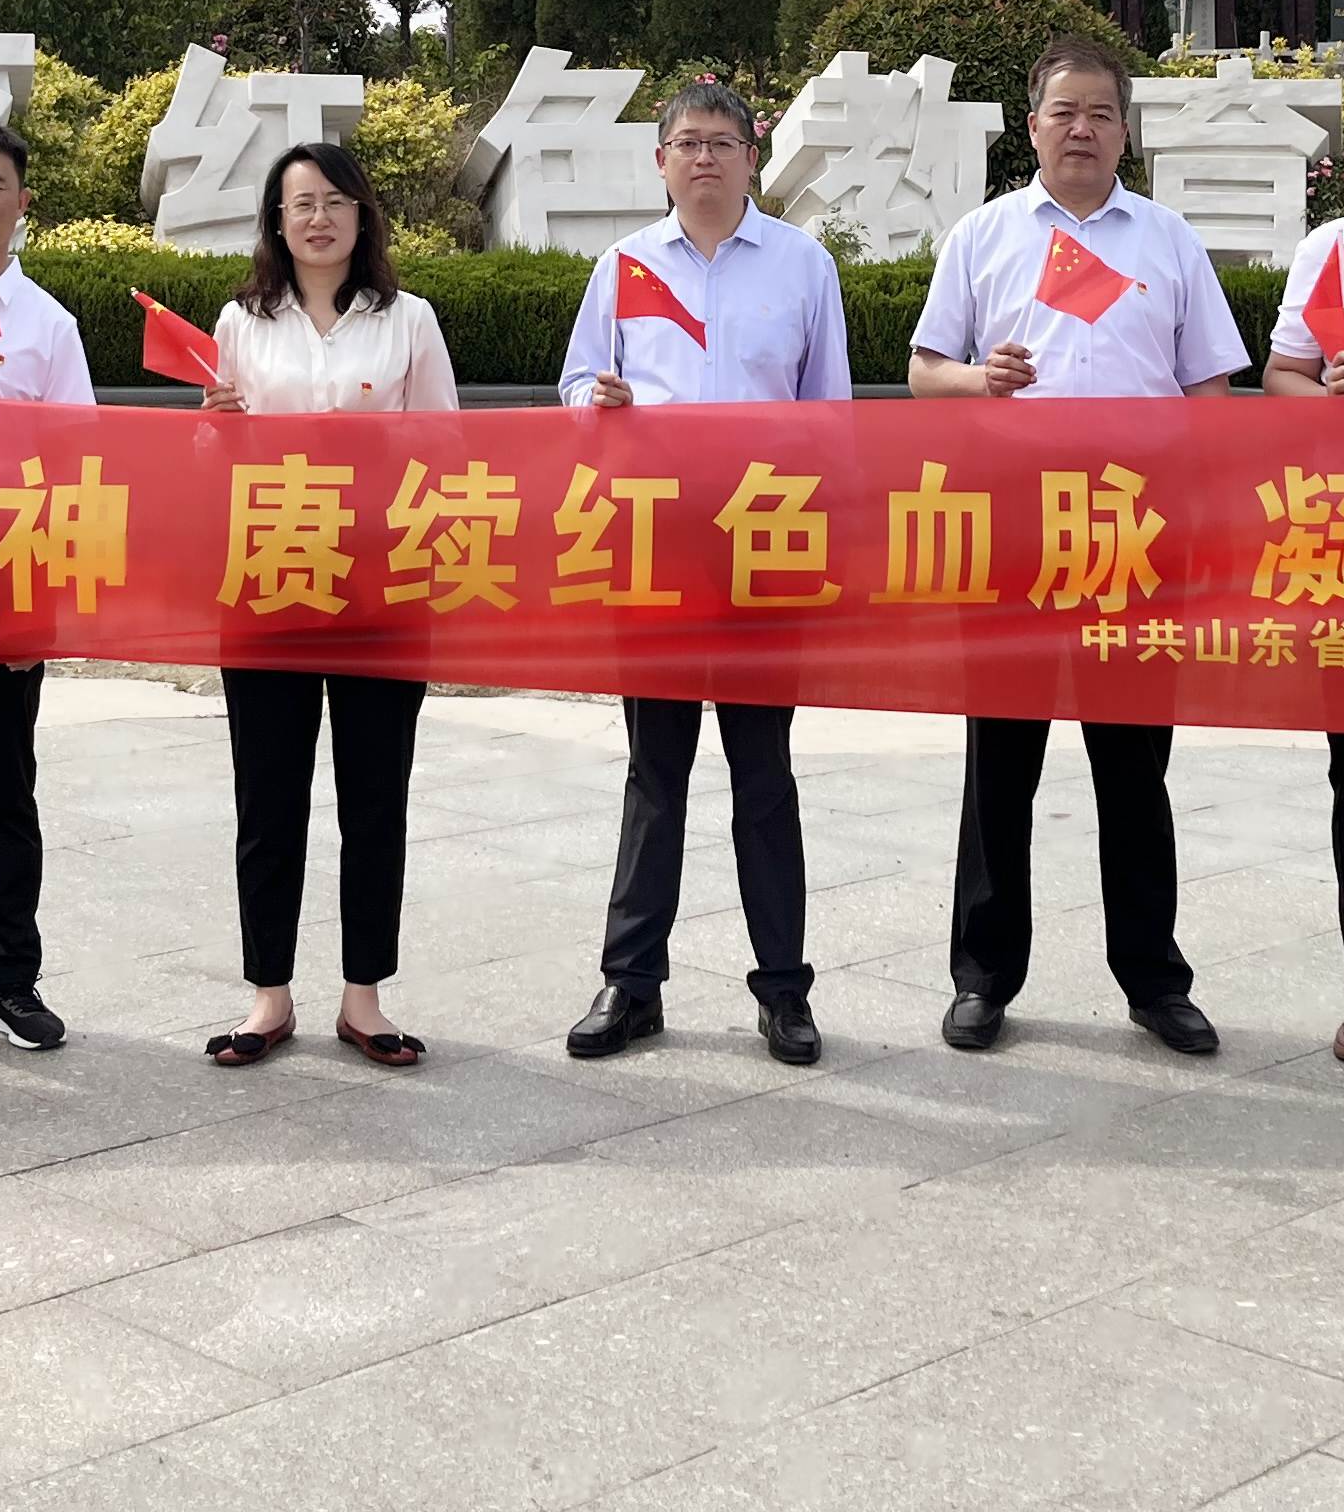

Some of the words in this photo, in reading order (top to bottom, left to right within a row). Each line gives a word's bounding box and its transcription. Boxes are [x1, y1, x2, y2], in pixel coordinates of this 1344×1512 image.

[216, 453, 1167, 615] 赓续红色血脉
